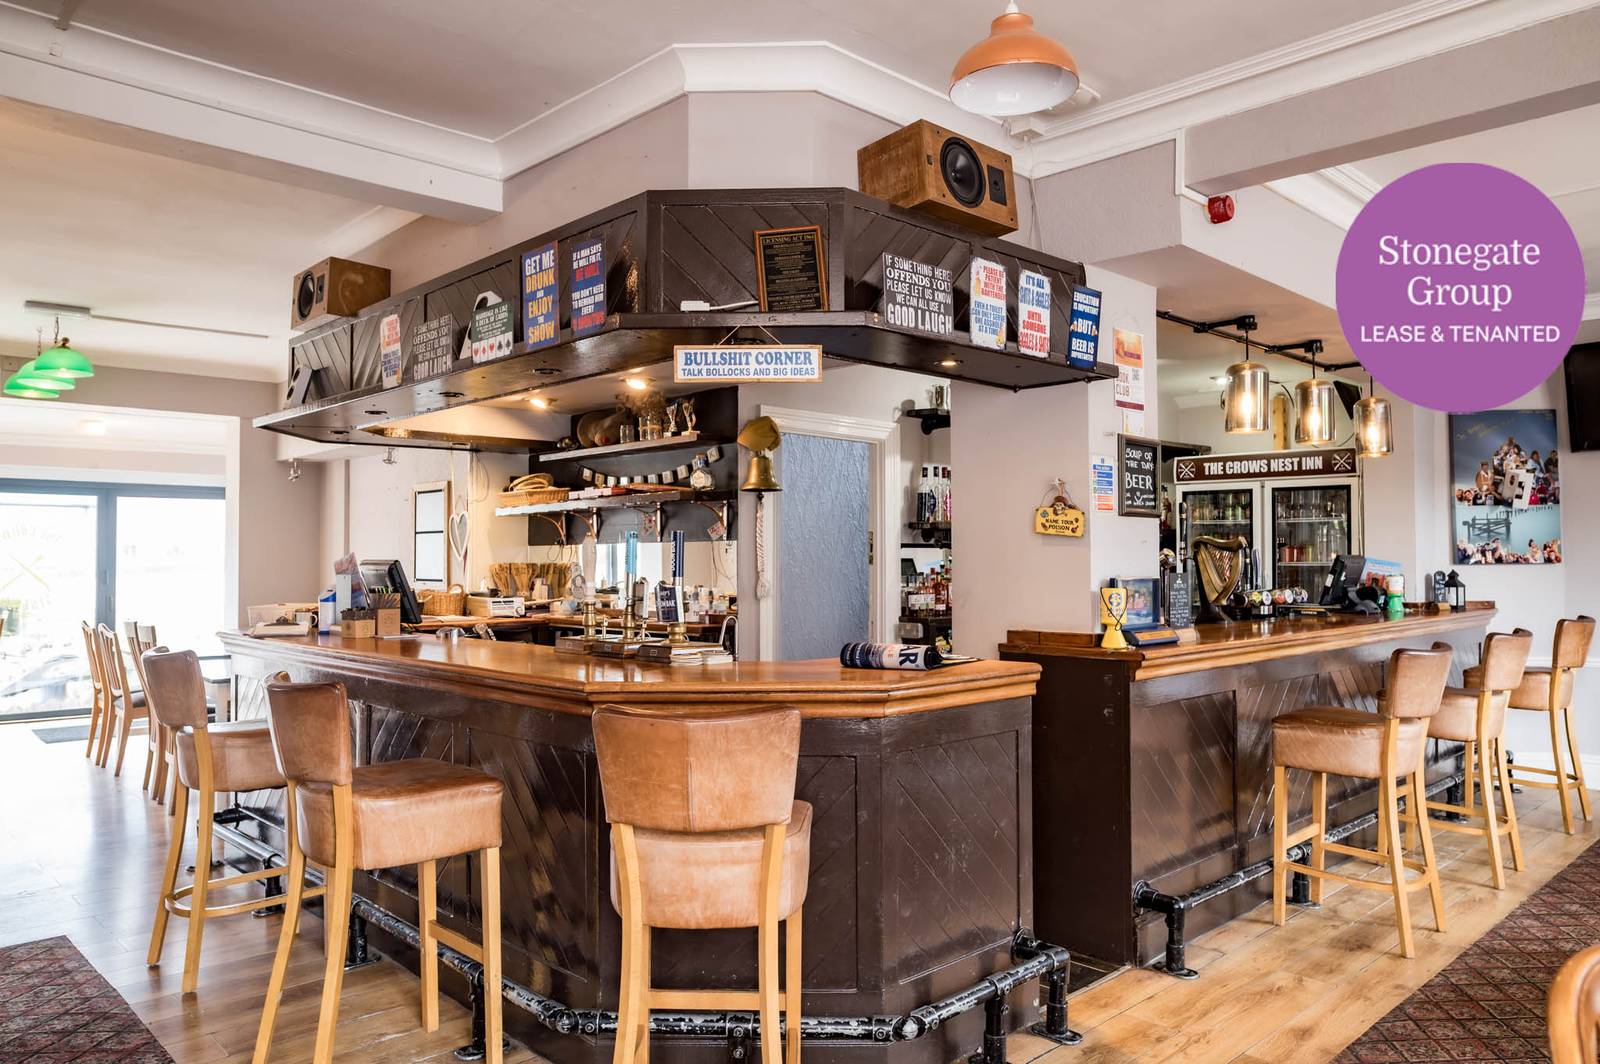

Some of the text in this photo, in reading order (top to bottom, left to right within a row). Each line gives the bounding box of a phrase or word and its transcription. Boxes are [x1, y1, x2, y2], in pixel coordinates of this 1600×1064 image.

[591, 243, 602, 254] SAYS
[526, 250, 554, 276] GET ME
[885, 255, 950, 282] IF SOMETHING HERE
[983, 266, 999, 276] PLEASE
[526, 268, 554, 293] DRUNK
[886, 267, 950, 292] OFFENDS YOU
[985, 274, 1001, 284] PATIENT
[1026, 275, 1035, 286] IT'S
[886, 279, 952, 304] PLEASE LET US KNOW
[528, 295, 552, 318] ENJOY
[896, 293, 944, 313] WE CAN ALL USE A
[887, 303, 952, 335] GOOD LAUGH
[1028, 310, 1041, 322] UNTIL
[528, 321, 554, 344] SHOW
[1023, 320, 1046, 334] SOMEONE
[1078, 318, 1092, 335] BUT
[414, 329, 438, 344] OFFENDS
[1072, 338, 1094, 354] BEER IS
[684, 351, 812, 366] BULLSHIT CORNER
[682, 368, 703, 376] TALK
[706, 368, 750, 376] BOLLOCKS
[753, 368, 770, 376] AND
[774, 368, 788, 376] BIG
[1116, 383, 1129, 397] CLUB
[1126, 448, 1152, 461] SOUP OF
[1204, 462, 1223, 475] THE
[1226, 460, 1268, 474] CROWS
[1270, 458, 1299, 472] NEST
[1302, 456, 1322, 470] INN
[1125, 472, 1153, 490] BEER
